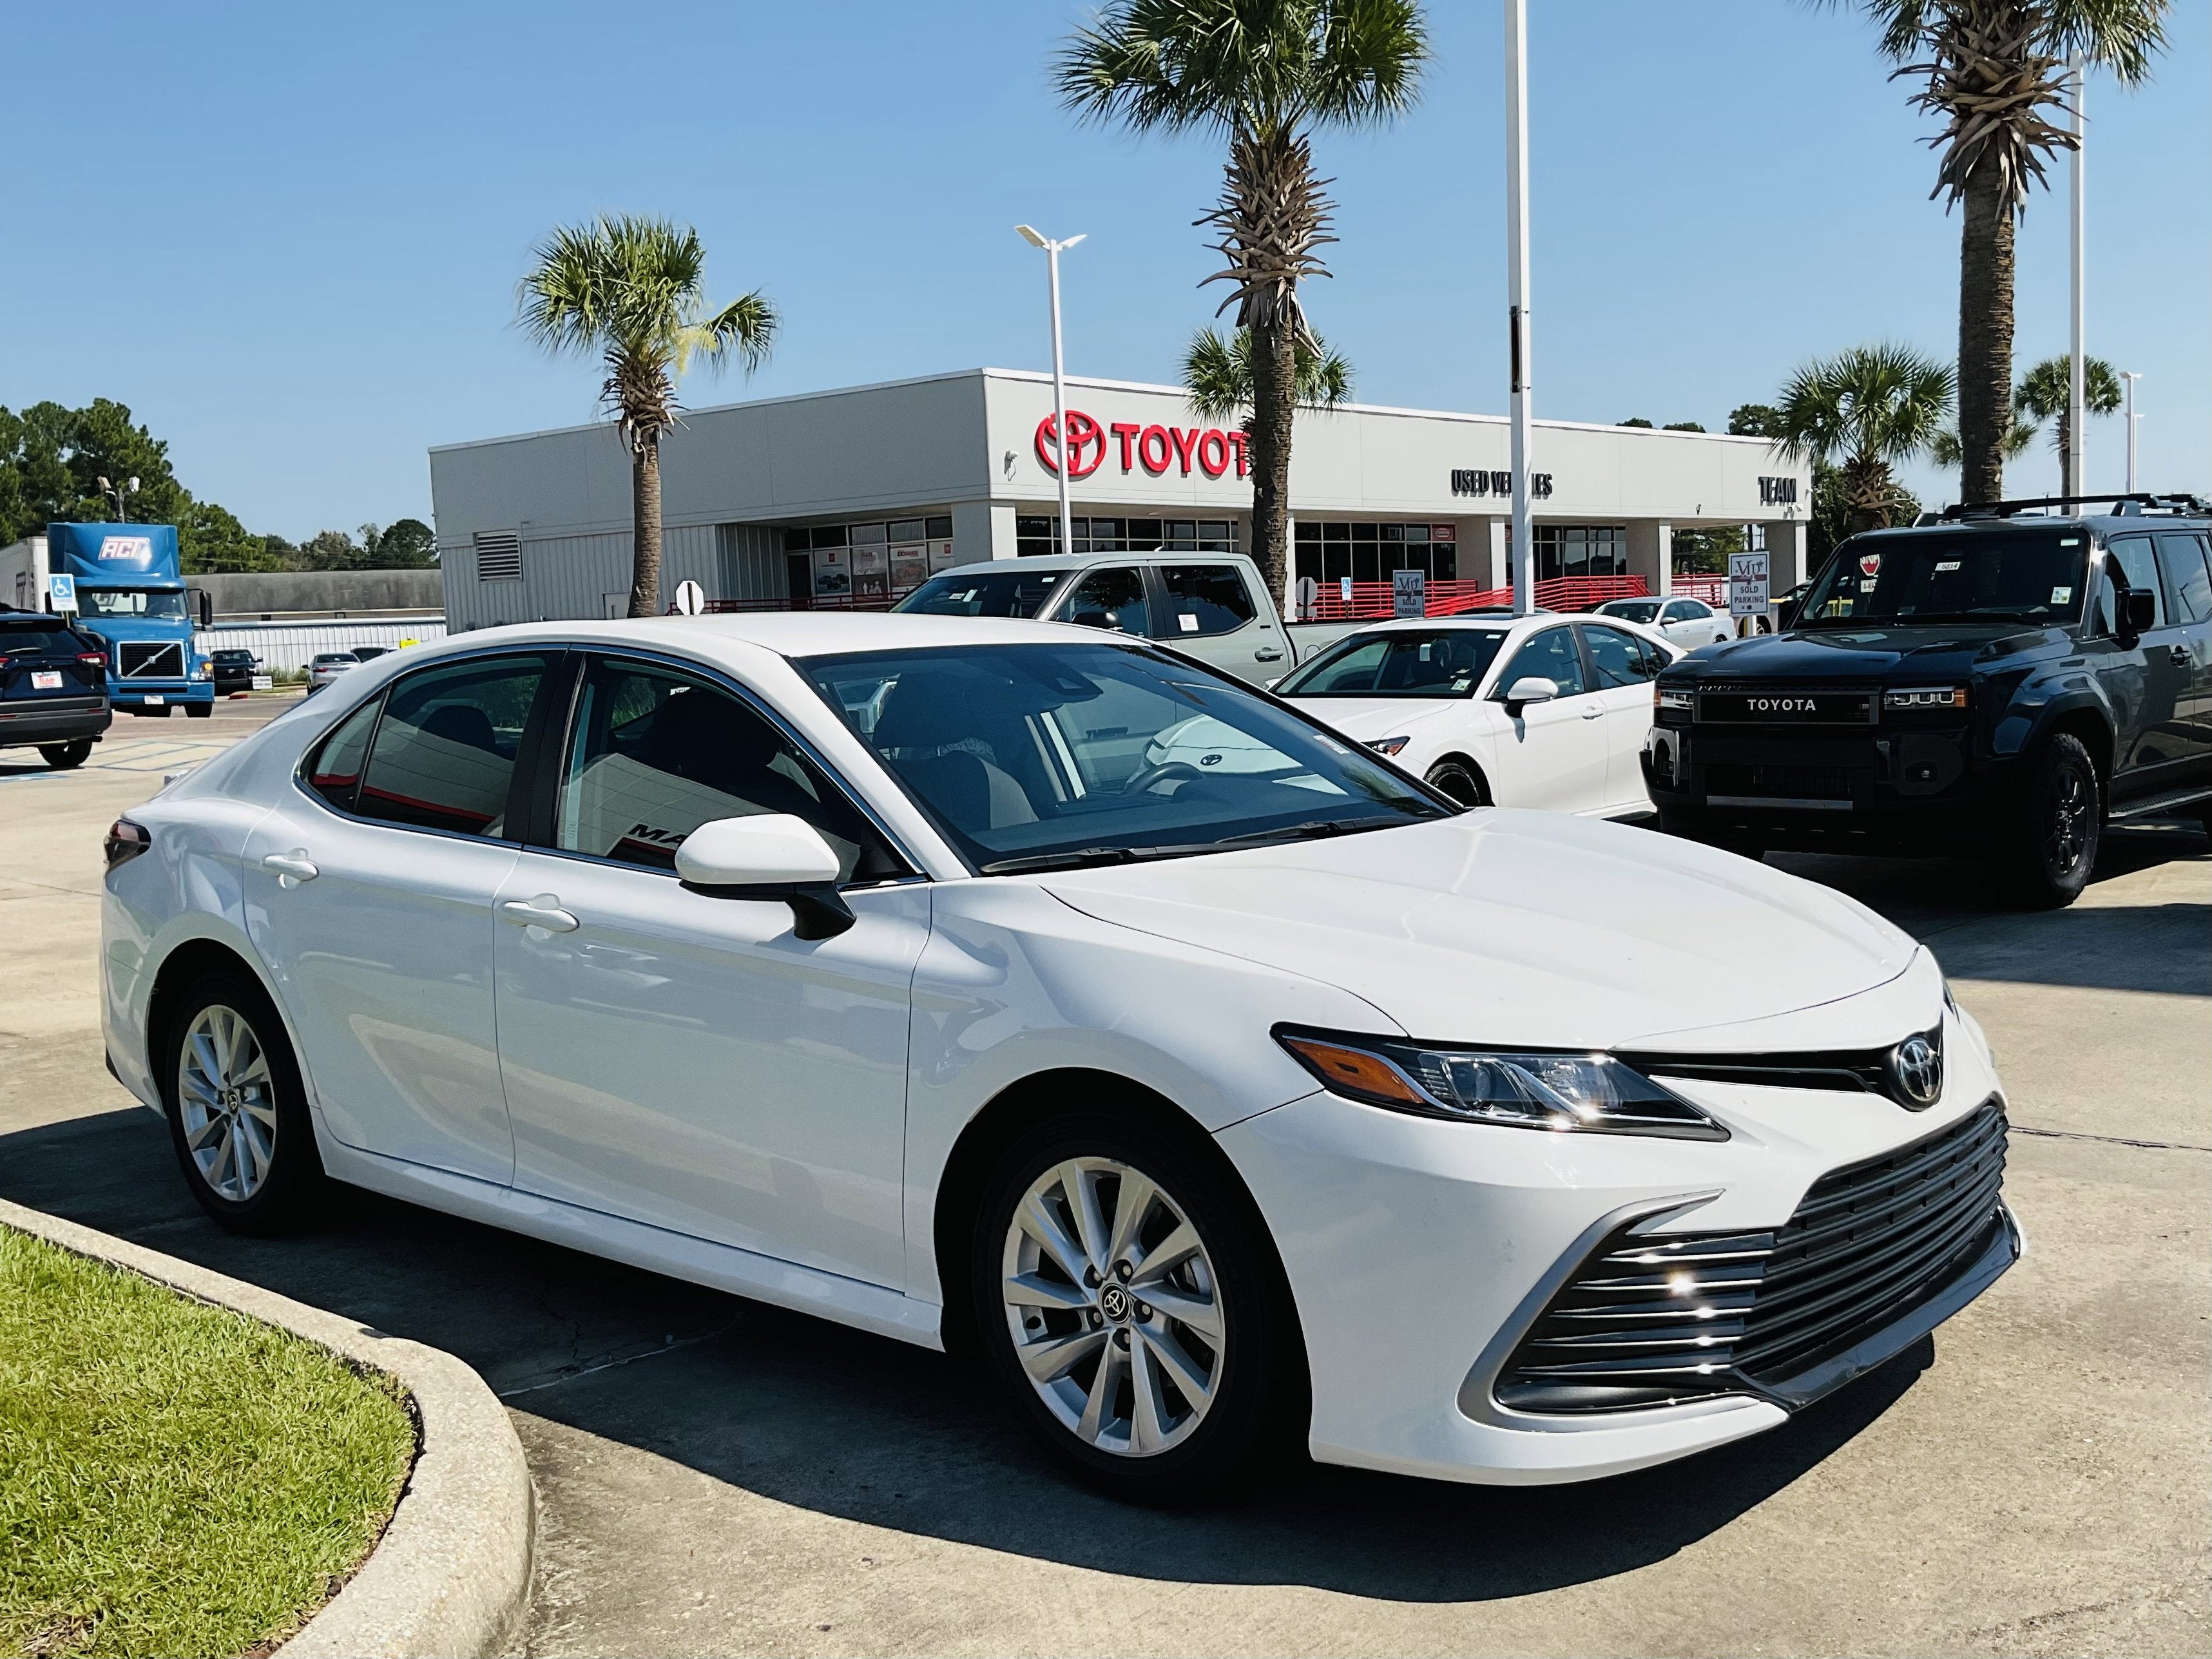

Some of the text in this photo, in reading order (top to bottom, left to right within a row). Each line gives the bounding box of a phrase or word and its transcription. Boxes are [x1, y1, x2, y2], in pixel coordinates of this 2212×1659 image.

[1111, 423, 1251, 475] TOYOT
[1451, 469, 1552, 495] USED VELES
[1758, 476, 1796, 503] TEAM
[1747, 699, 1816, 711] TOYOTA
